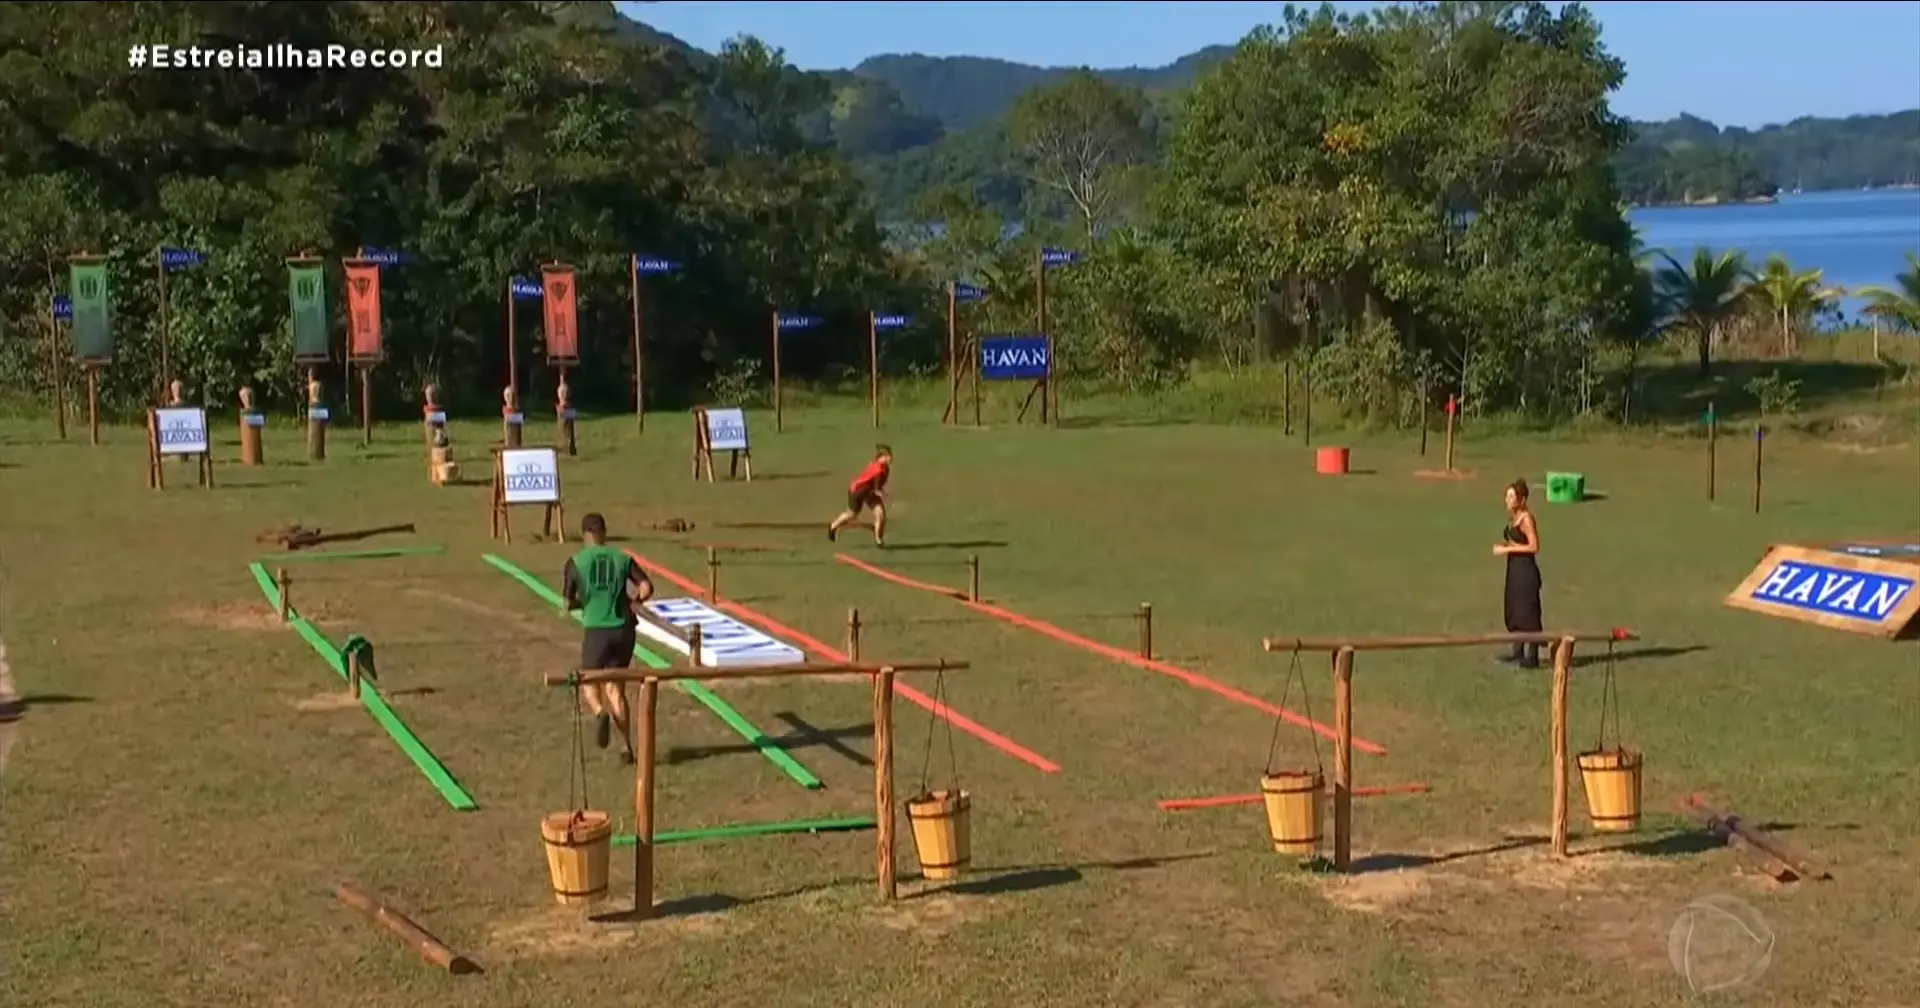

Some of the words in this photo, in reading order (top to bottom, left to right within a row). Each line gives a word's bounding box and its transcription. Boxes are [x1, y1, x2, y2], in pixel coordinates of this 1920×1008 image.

[637, 260, 669, 271] HAVAN
[983, 347, 1047, 367] HAVAN
[162, 430, 203, 443] HAVAN
[508, 475, 555, 489] HAVAN
[1756, 565, 1910, 615] HAVAN
